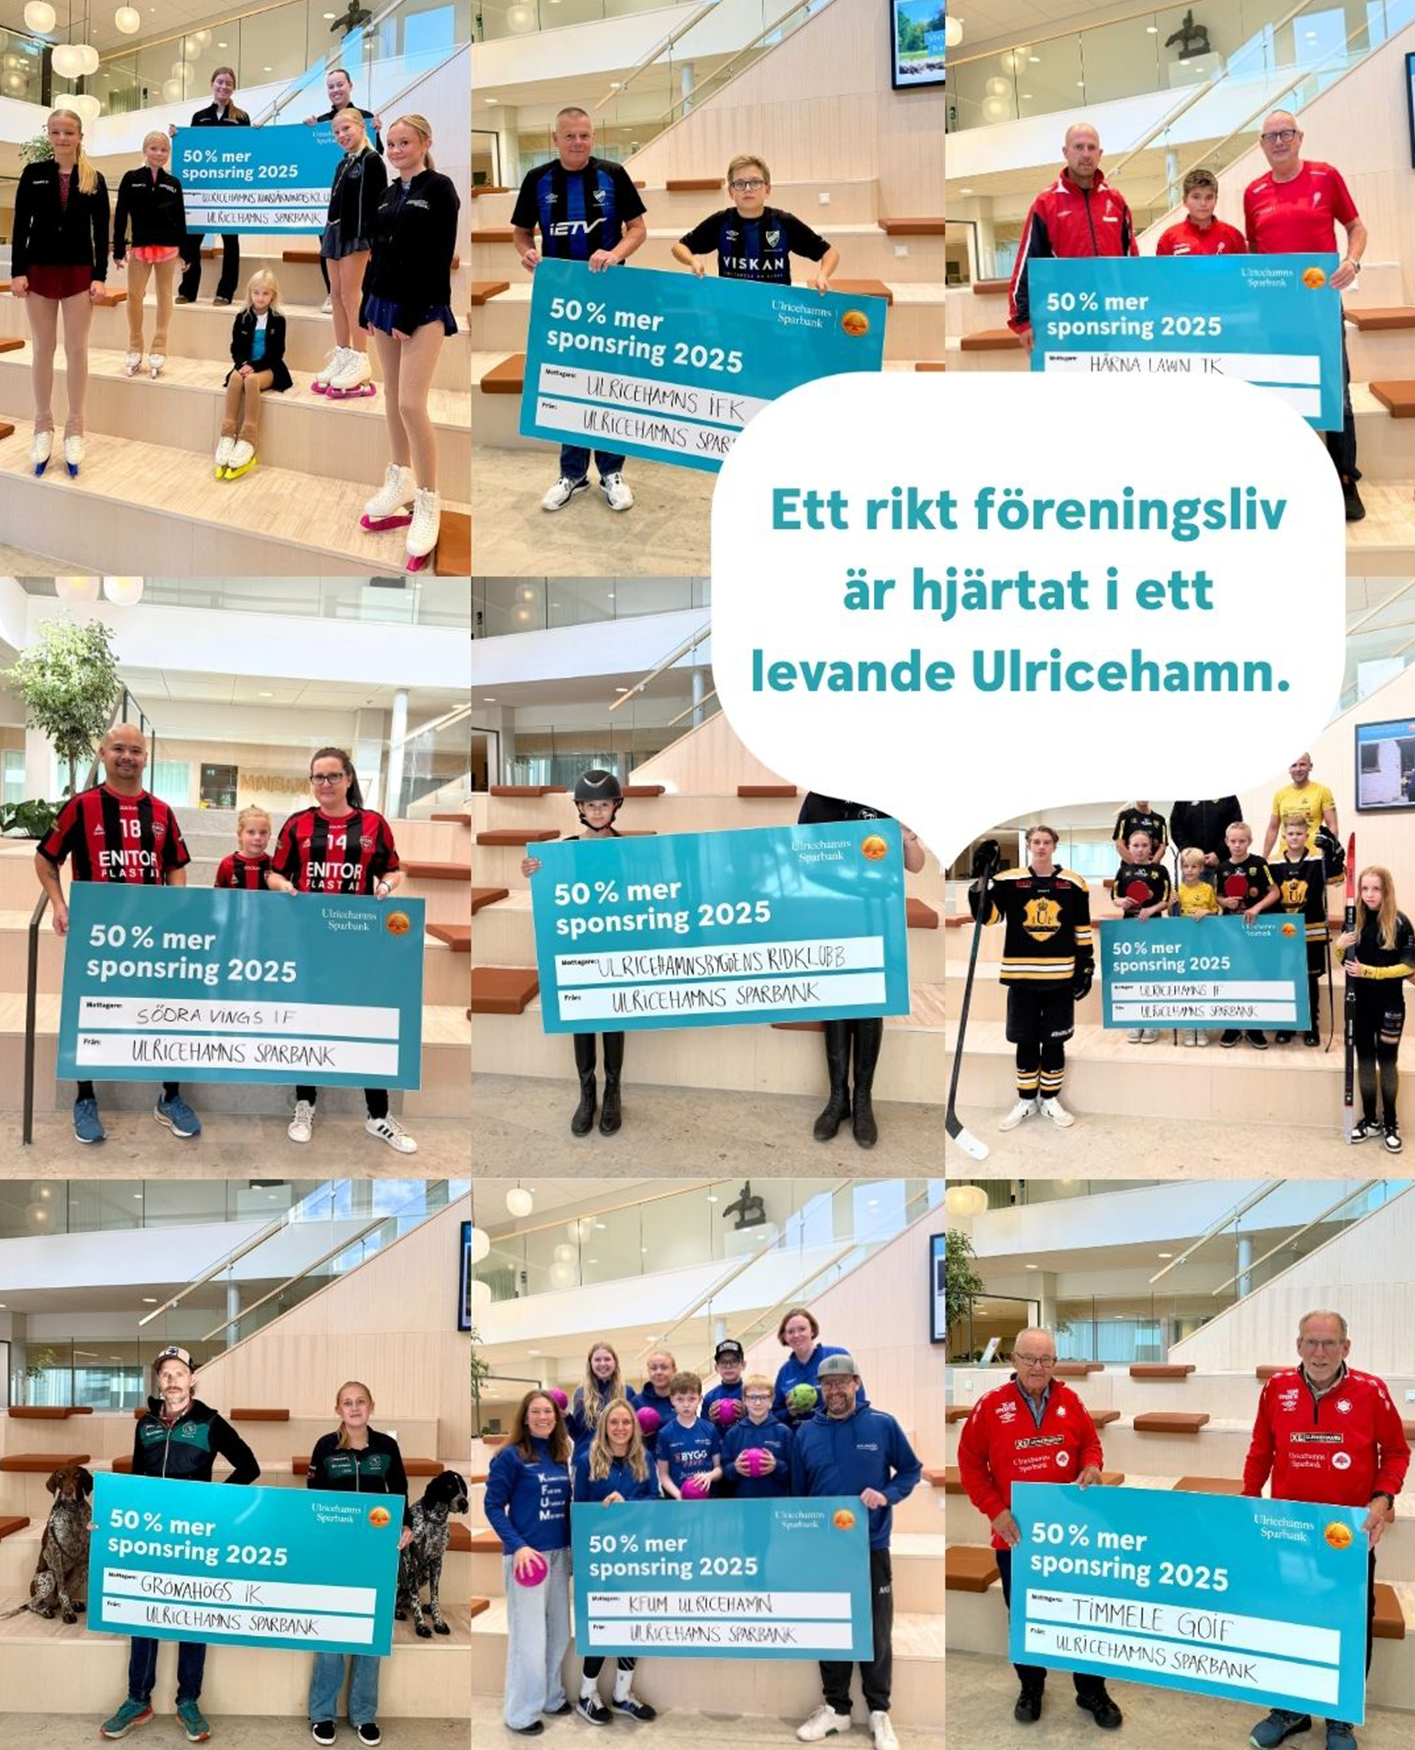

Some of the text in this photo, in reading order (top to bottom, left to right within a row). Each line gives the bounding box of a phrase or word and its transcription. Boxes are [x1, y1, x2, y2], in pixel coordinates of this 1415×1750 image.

[183, 150, 202, 163] 50
[222, 151, 252, 163] mer
[182, 165, 298, 182] sponsring 2025
[206, 211, 323, 224] ULRICEHAMNS SPARBANK
[723, 256, 784, 270] VISKAN
[771, 299, 833, 318] Ulricehamns
[1046, 292, 1076, 312] 50
[1104, 294, 1149, 311] mer
[549, 297, 583, 321] 50
[614, 309, 665, 332] mer
[777, 312, 824, 329] Sparbank
[1046, 316, 1222, 340] sponsring 2025
[547, 329, 744, 374] sponsring 2025
[1148, 357, 1191, 373] LAWN
[587, 375, 746, 422] ULRICEHAMNS IFK
[583, 409, 687, 448] ULRICEHAMNS
[119, 818, 142, 838] 18
[327, 834, 348, 850] 14
[791, 838, 851, 852] Ulricehamns
[98, 850, 158, 867] ENITOR
[798, 850, 844, 865] Sparbank
[101, 868, 145, 878] PLAST
[306, 861, 363, 879] ENITOR
[305, 879, 344, 890] PLAST
[554, 882, 591, 907] 50
[627, 880, 682, 902] mer
[321, 907, 377, 921] Ulricehamns
[556, 900, 771, 940] sponsring 2025
[328, 919, 370, 932] Sparbank
[88, 924, 126, 947] 50
[162, 931, 216, 951] mer
[768, 946, 846, 971] RIDKLUBB
[1112, 942, 1132, 955] 50
[1151, 943, 1182, 954] mer
[86, 956, 298, 986] sponsring 2025
[1113, 956, 1231, 975] sponsring 2025
[611, 981, 821, 1014] ULRICEHAMNS SPARBANK
[136, 1004, 202, 1025] SÖDRA
[274, 1009, 298, 1025] IF
[1210, 1005, 1258, 1018] SPARBANK
[132, 1038, 336, 1067] ULRICEHAMNS SPARBANK
[311, 1502, 362, 1515] Ulricehamns
[316, 1512, 354, 1524] Sparbank
[109, 1508, 140, 1529] 50
[170, 1519, 216, 1537] mer
[1253, 1513, 1315, 1530] Ulricehamns
[1031, 1521, 1065, 1544] 50
[1097, 1528, 1148, 1551] mer
[1260, 1525, 1307, 1542] Sparbank
[107, 1536, 287, 1566] sponsring 2025
[589, 1535, 617, 1553] 50
[645, 1536, 688, 1552] mer
[589, 1557, 758, 1581] sponsring 2025
[1030, 1554, 1230, 1592] sponsring 2025
[140, 1575, 265, 1605] GRÖNAHÖGS IK
[629, 1594, 773, 1614] KFUM ULRICEHAMN
[145, 1605, 320, 1636] ULRICEHAMNS SPARBANK
[1072, 1598, 1164, 1631] TIMMELE
[630, 1623, 798, 1644] ULRICEHAMNS SPARBANK
[1056, 1635, 1259, 1683] ULRICEHAMNS SPARBANK
